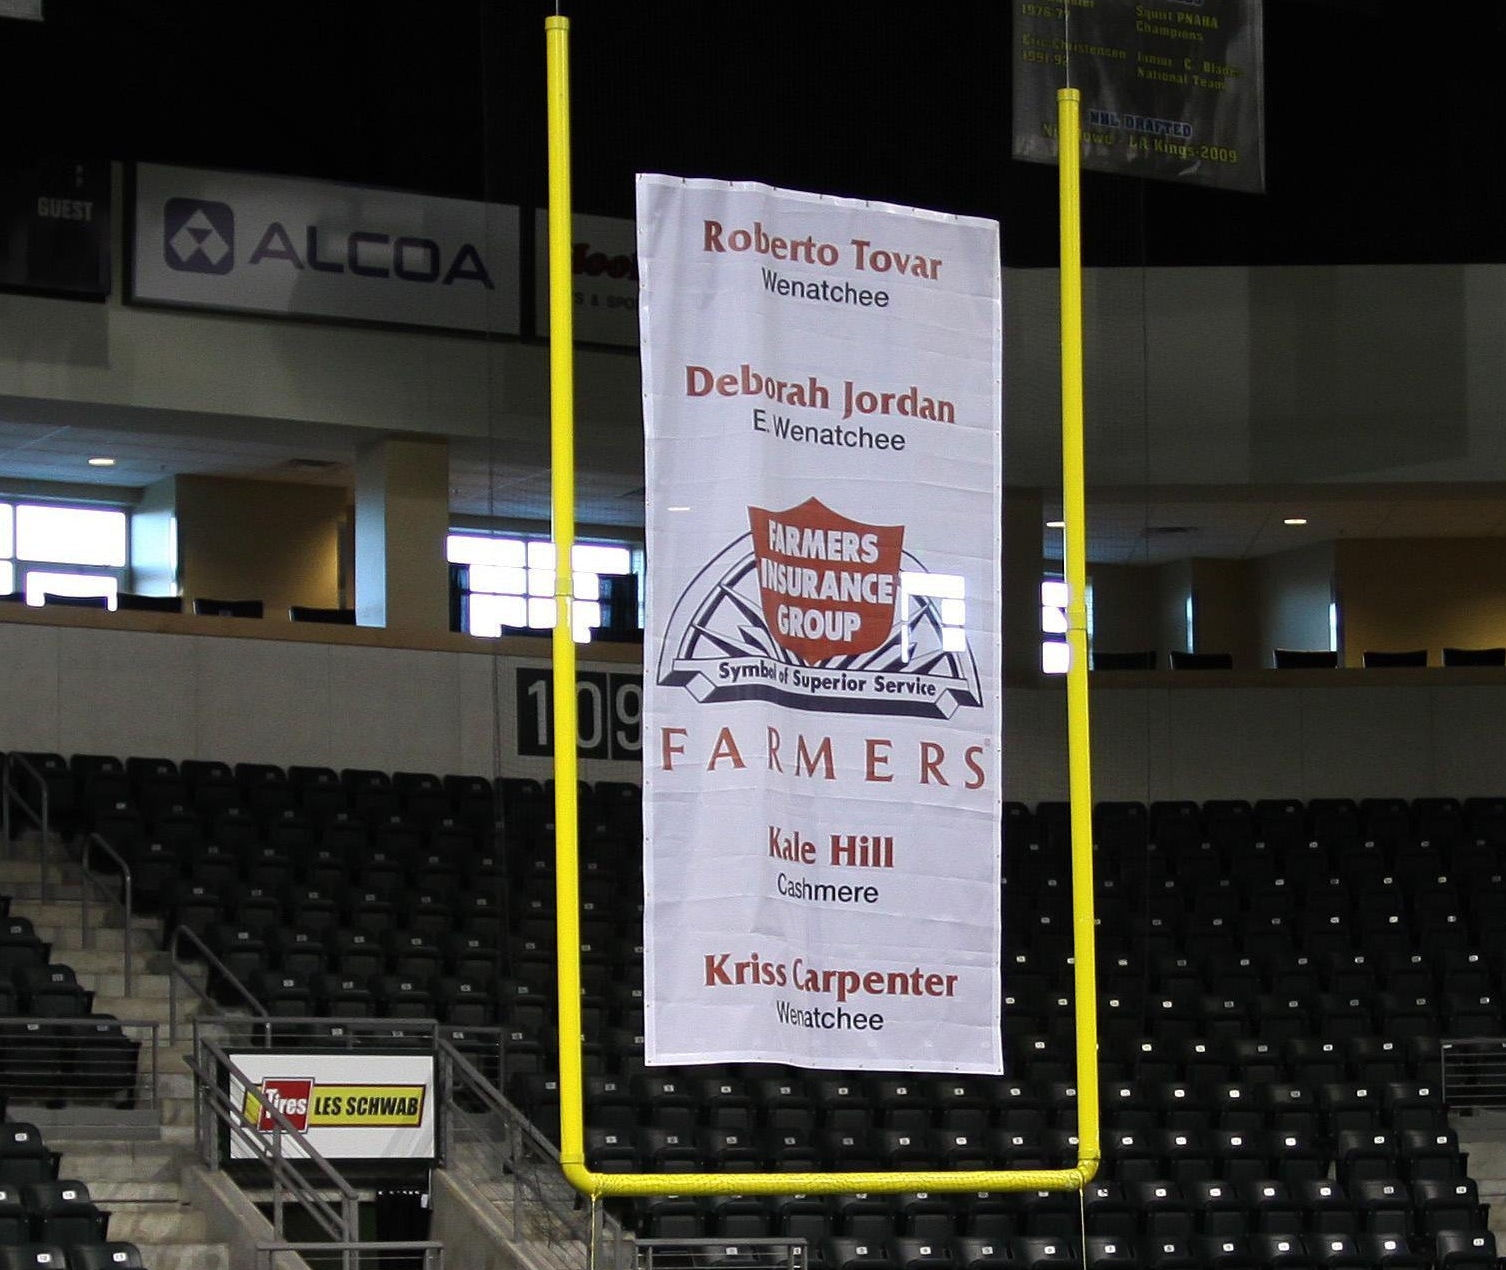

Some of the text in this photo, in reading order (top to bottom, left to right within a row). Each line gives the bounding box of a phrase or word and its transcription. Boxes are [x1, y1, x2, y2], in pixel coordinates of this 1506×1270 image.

[37, 196, 93, 221] GUEST
[248, 222, 495, 290] ALCOA
[703, 219, 943, 280] Roberto Tovar
[761, 266, 889, 307] Wenatchee
[686, 364, 955, 424] Deborah Jordan
[773, 416, 906, 451] Wenatchee
[768, 519, 879, 564] FARMERS
[761, 557, 894, 604] INSURANCE
[776, 606, 862, 642] GROUP
[718, 661, 937, 696] Symbol of Superior Service
[661, 726, 986, 790] FARMERS
[768, 825, 894, 868] Kale Hill
[777, 873, 879, 903] Cashmere
[704, 952, 959, 1002] Kriss Carpenter
[776, 1001, 884, 1030] Wenatchee
[313, 1096, 341, 1116] LES
[345, 1096, 420, 1116] SCHWAB
